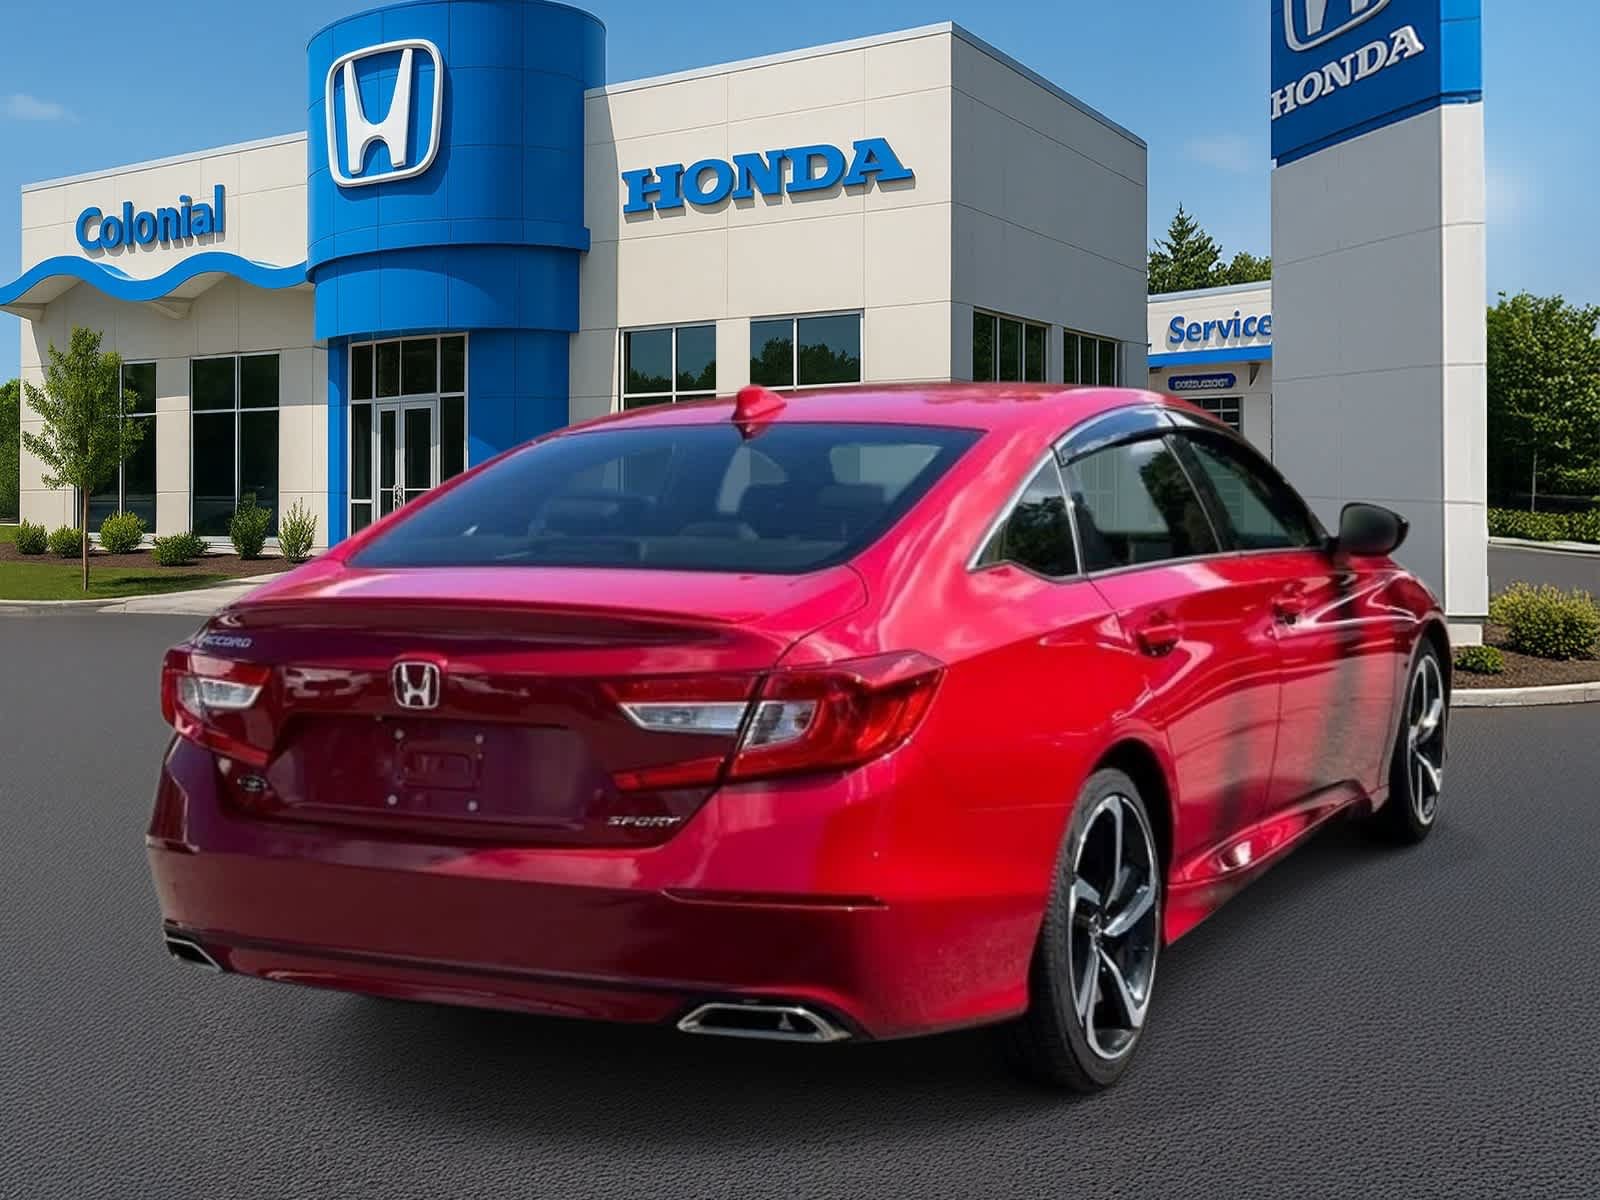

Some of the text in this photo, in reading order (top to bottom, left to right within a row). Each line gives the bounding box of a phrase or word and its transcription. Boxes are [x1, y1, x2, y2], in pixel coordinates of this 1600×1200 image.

[1271, 25, 1424, 120] HONDA
[621, 137, 913, 213] HONDA
[76, 184, 225, 251] Colonial
[1169, 310, 1272, 344] Service
[608, 816, 681, 827] SPORT
